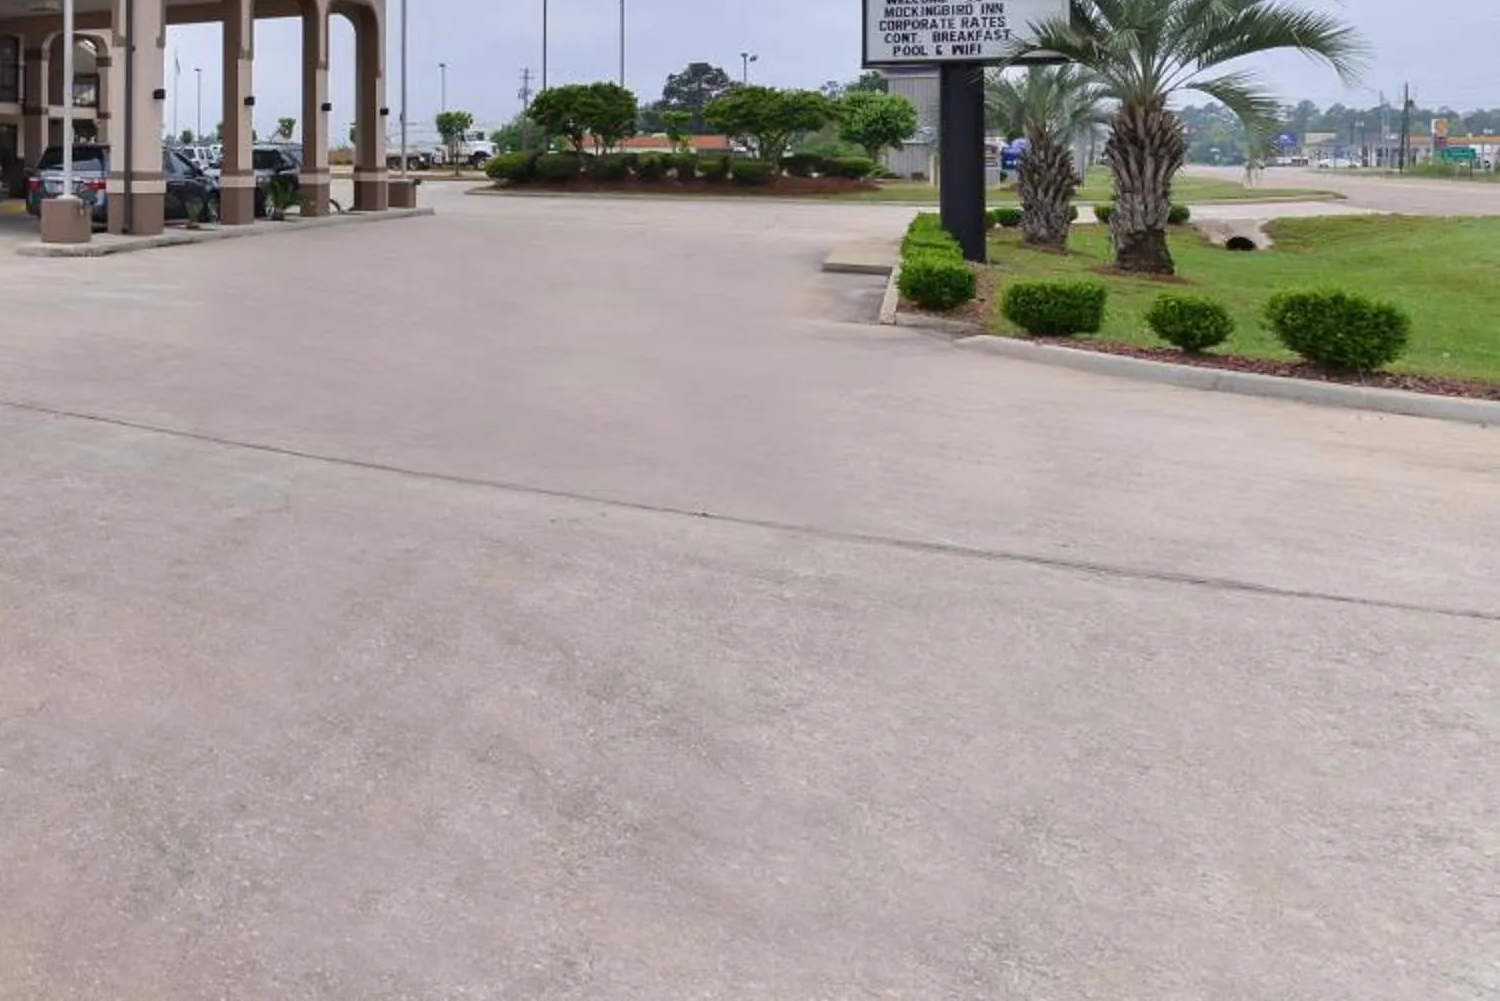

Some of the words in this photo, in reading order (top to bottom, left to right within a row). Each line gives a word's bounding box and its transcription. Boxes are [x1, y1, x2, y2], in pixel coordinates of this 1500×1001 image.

[884, 3, 973, 18] MOCKINGBIRD
[981, 2, 1004, 15] INN
[879, 17, 958, 31] CORPORATE
[961, 16, 1005, 28] RATES
[884, 32, 922, 44] CONT.
[932, 29, 1011, 43] BREAKFAST
[893, 44, 928, 56] POOL
[951, 43, 981, 56] WIFI
